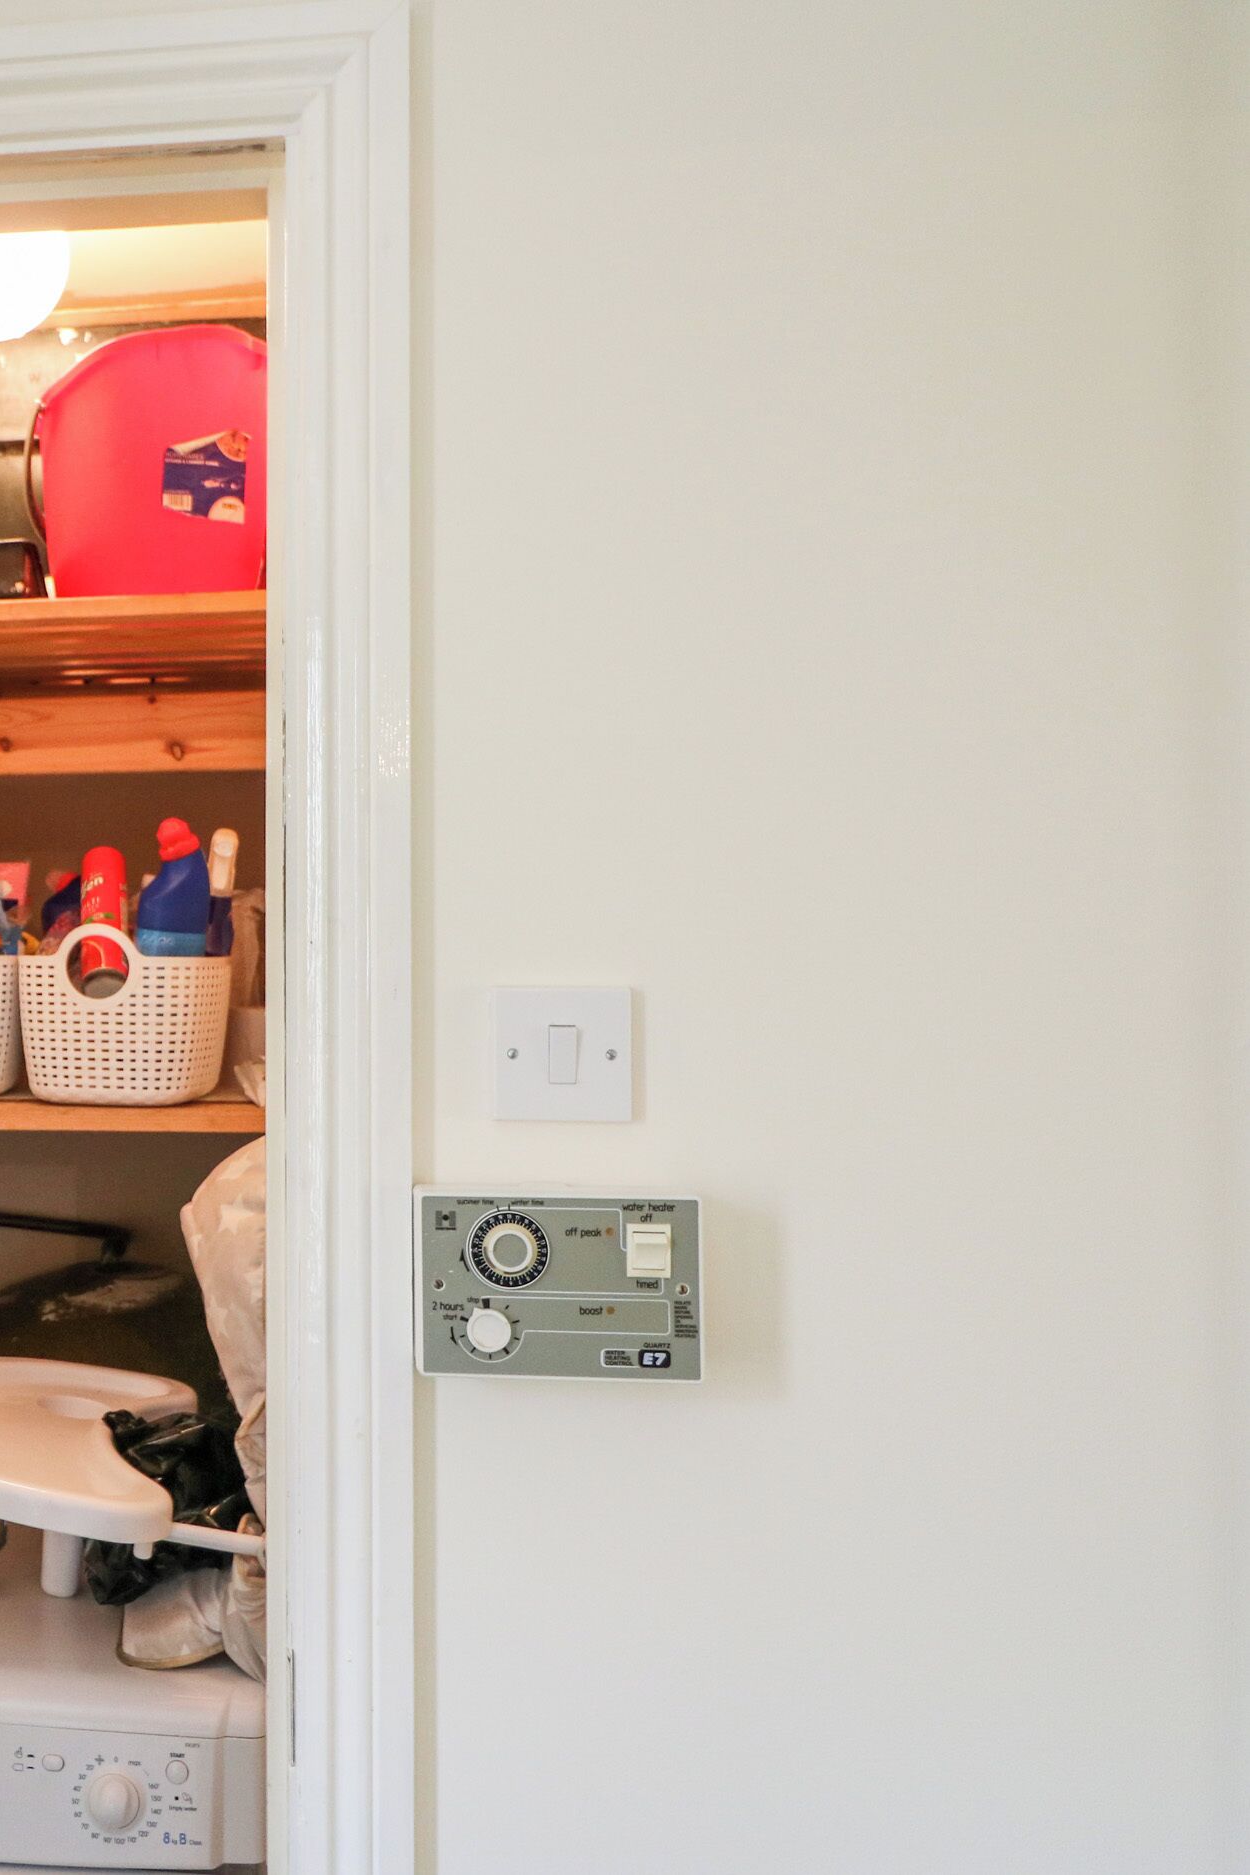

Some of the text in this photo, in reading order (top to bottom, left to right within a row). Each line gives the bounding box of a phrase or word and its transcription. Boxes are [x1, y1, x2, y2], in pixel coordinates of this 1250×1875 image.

[622, 1202, 676, 1212] water heater
[640, 1213, 653, 1223] off
[565, 1227, 602, 1239] off peak
[466, 1296, 480, 1304] stop
[432, 1301, 465, 1311] 2 hours
[579, 1305, 603, 1316] boost
[442, 1313, 457, 1321] start
[642, 1352, 667, 1366] E7
[163, 1832, 170, 1845] 8
